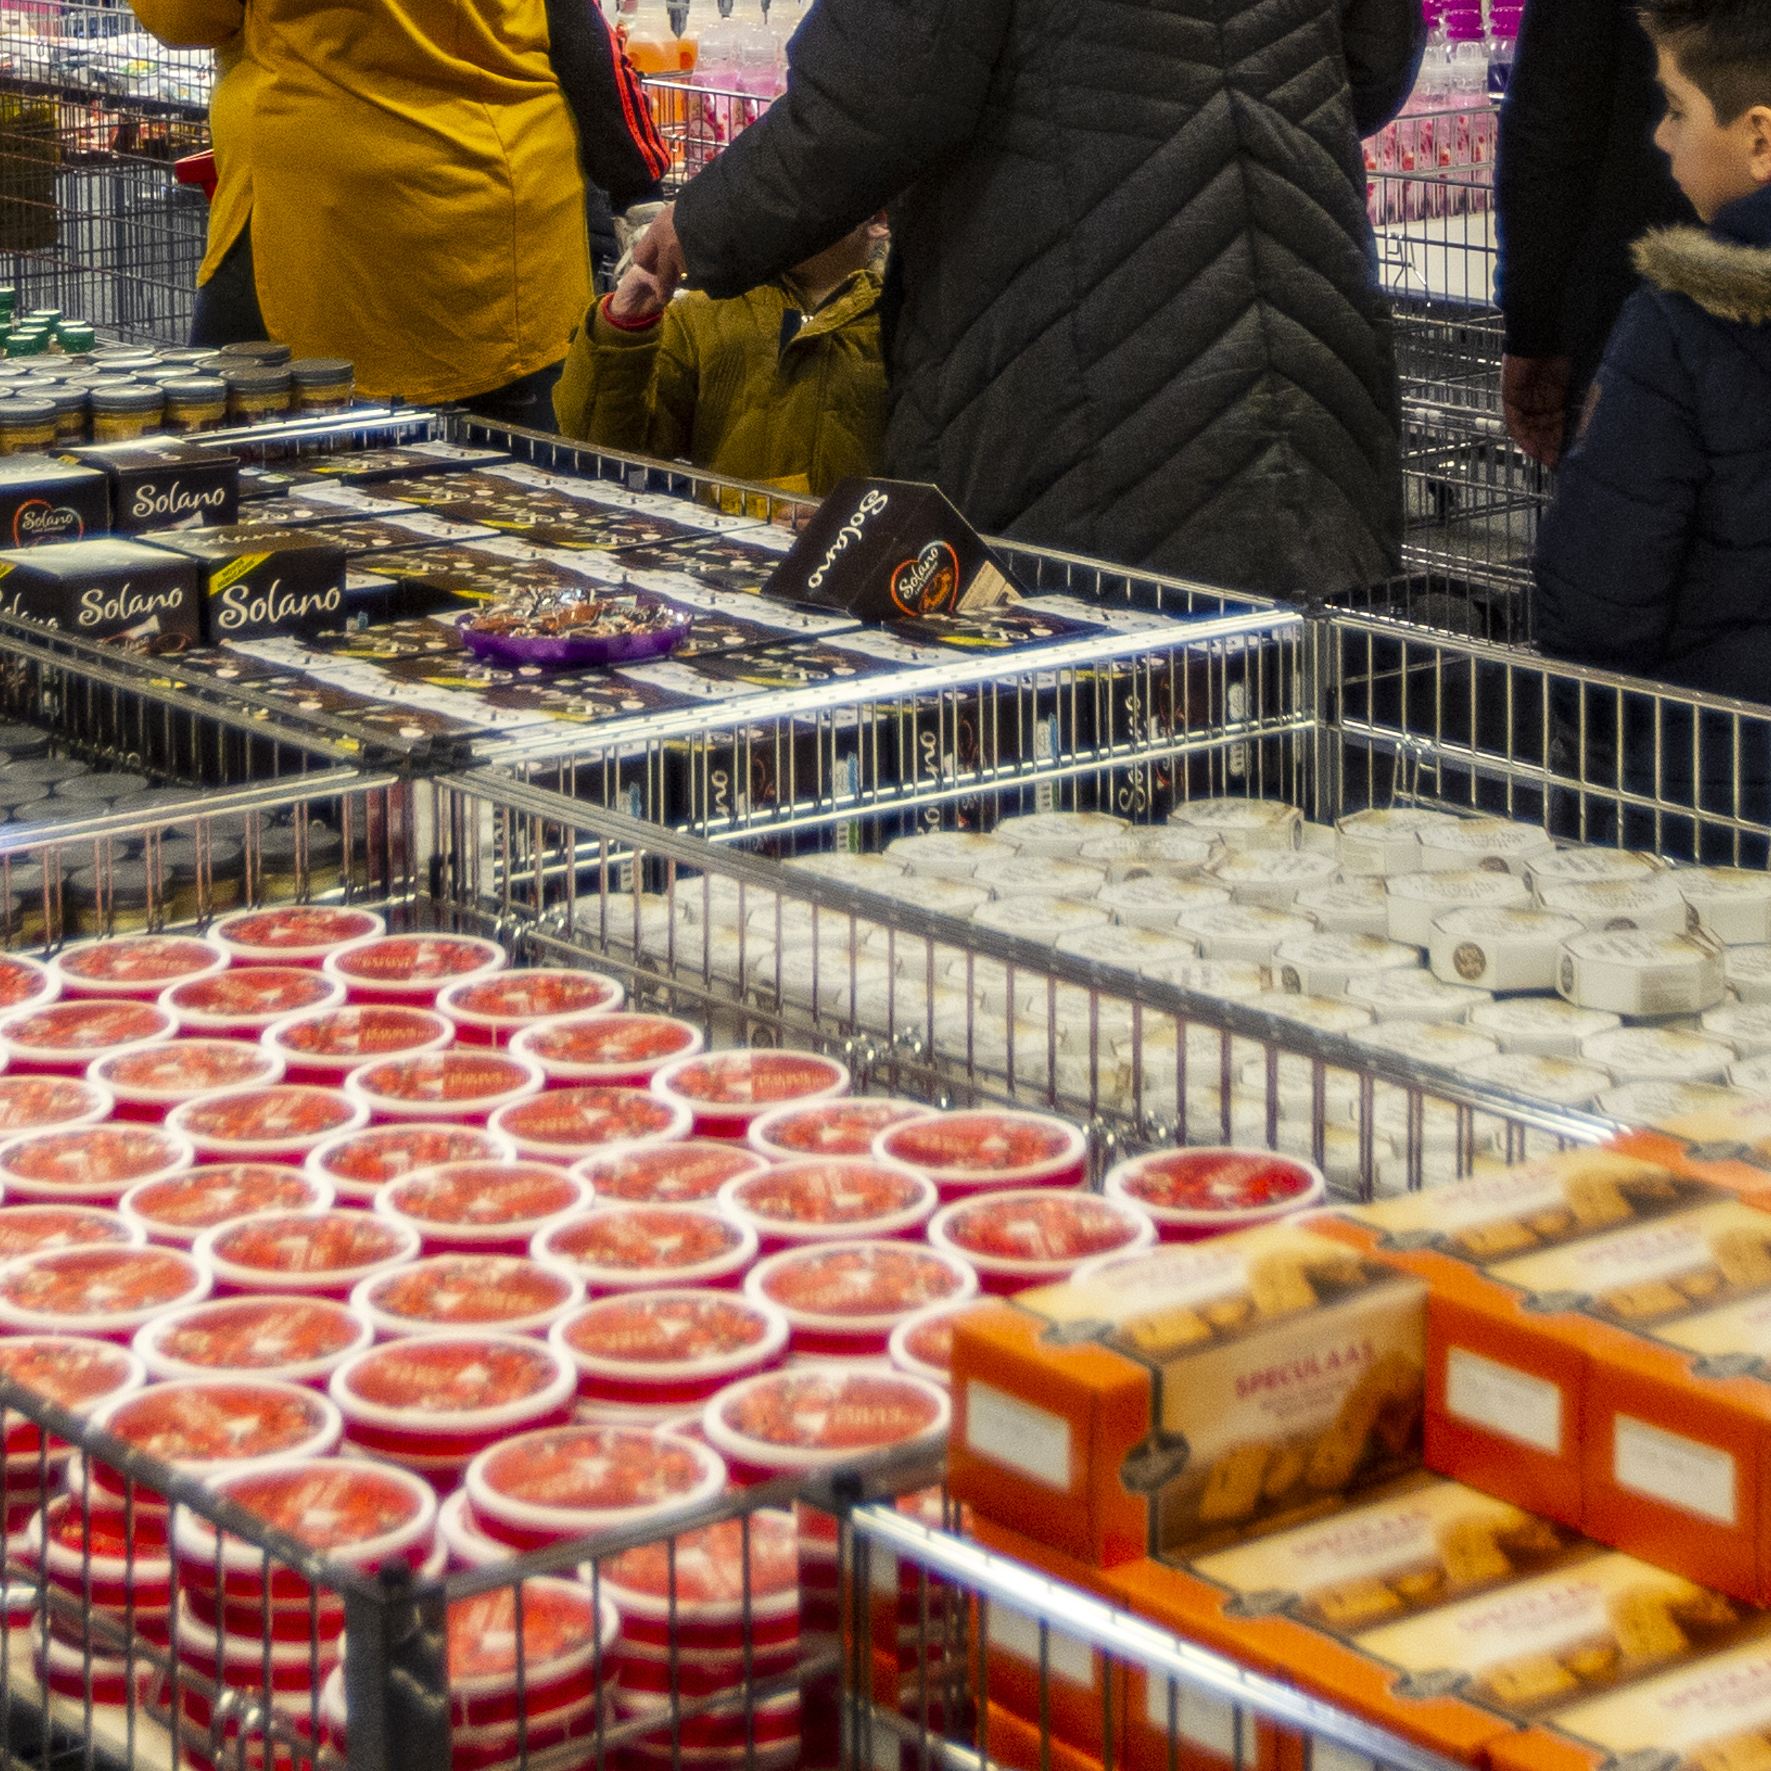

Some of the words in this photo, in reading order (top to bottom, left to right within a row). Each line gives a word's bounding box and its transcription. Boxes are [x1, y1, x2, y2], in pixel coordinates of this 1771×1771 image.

[22, 508, 74, 529] Solano
[131, 480, 226, 518] Solano
[807, 489, 889, 588] Solano
[898, 546, 939, 601] Solano
[78, 582, 184, 627] Solano
[217, 578, 342, 629] Solano
[1234, 1338, 1376, 1399] SPECULAAS
